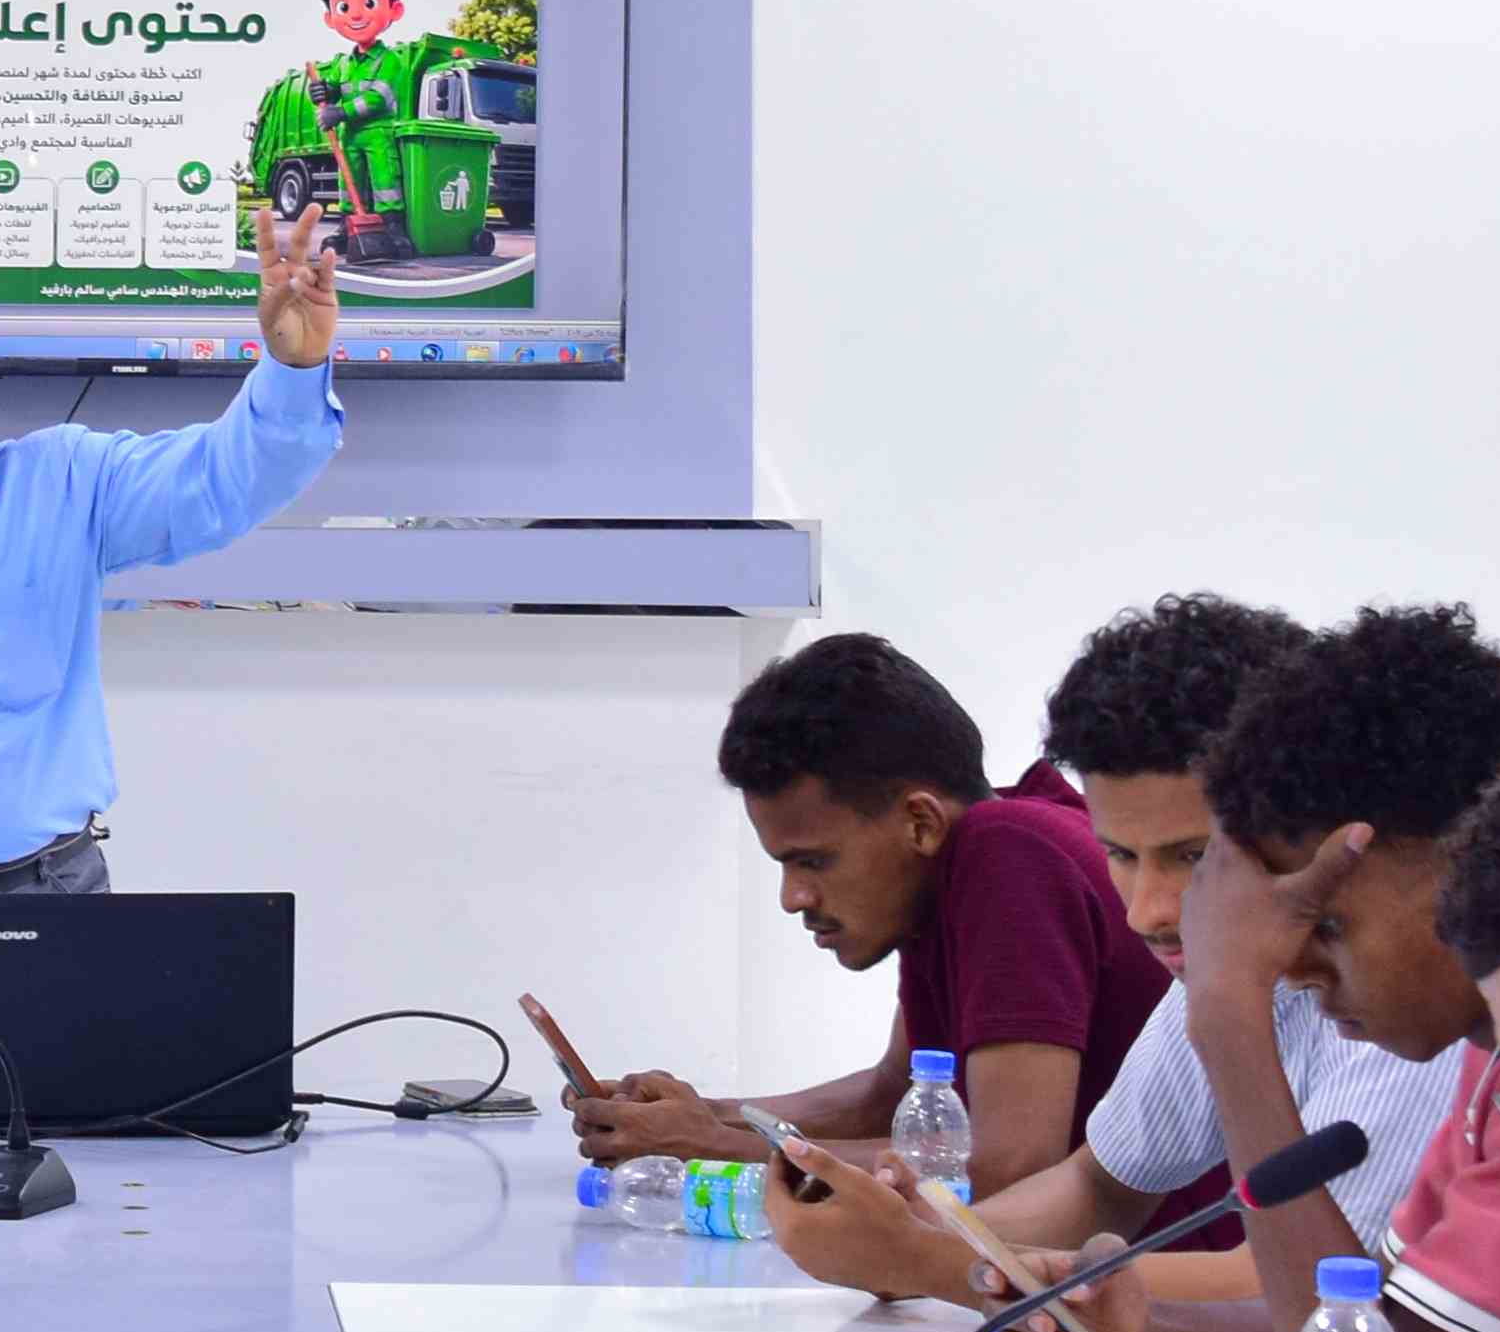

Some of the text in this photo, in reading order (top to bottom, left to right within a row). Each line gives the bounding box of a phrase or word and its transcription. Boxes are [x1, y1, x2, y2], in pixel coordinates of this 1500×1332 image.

[81, 1, 267, 54] محتوى
[33, 67, 60, 81] شهر
[63, 66, 92, 79] لمدة
[95, 68, 137, 81] محتوى
[171, 67, 202, 82] اكتب
[72, 90, 125, 102] النظافة
[128, 91, 184, 105] لصندوق
[114, 113, 184, 128] الفيديوهات
[30, 136, 77, 152] لمجتمع
[80, 136, 132, 150] المناسبة
[78, 202, 122, 214] التصاميم
[152, 202, 231, 214] الرسائل التوعوية
[74, 284, 105, 298] سالم
[106, 285, 139, 301] سامي
[140, 285, 189, 299] المهندس
[224, 286, 258, 299] مدرب
